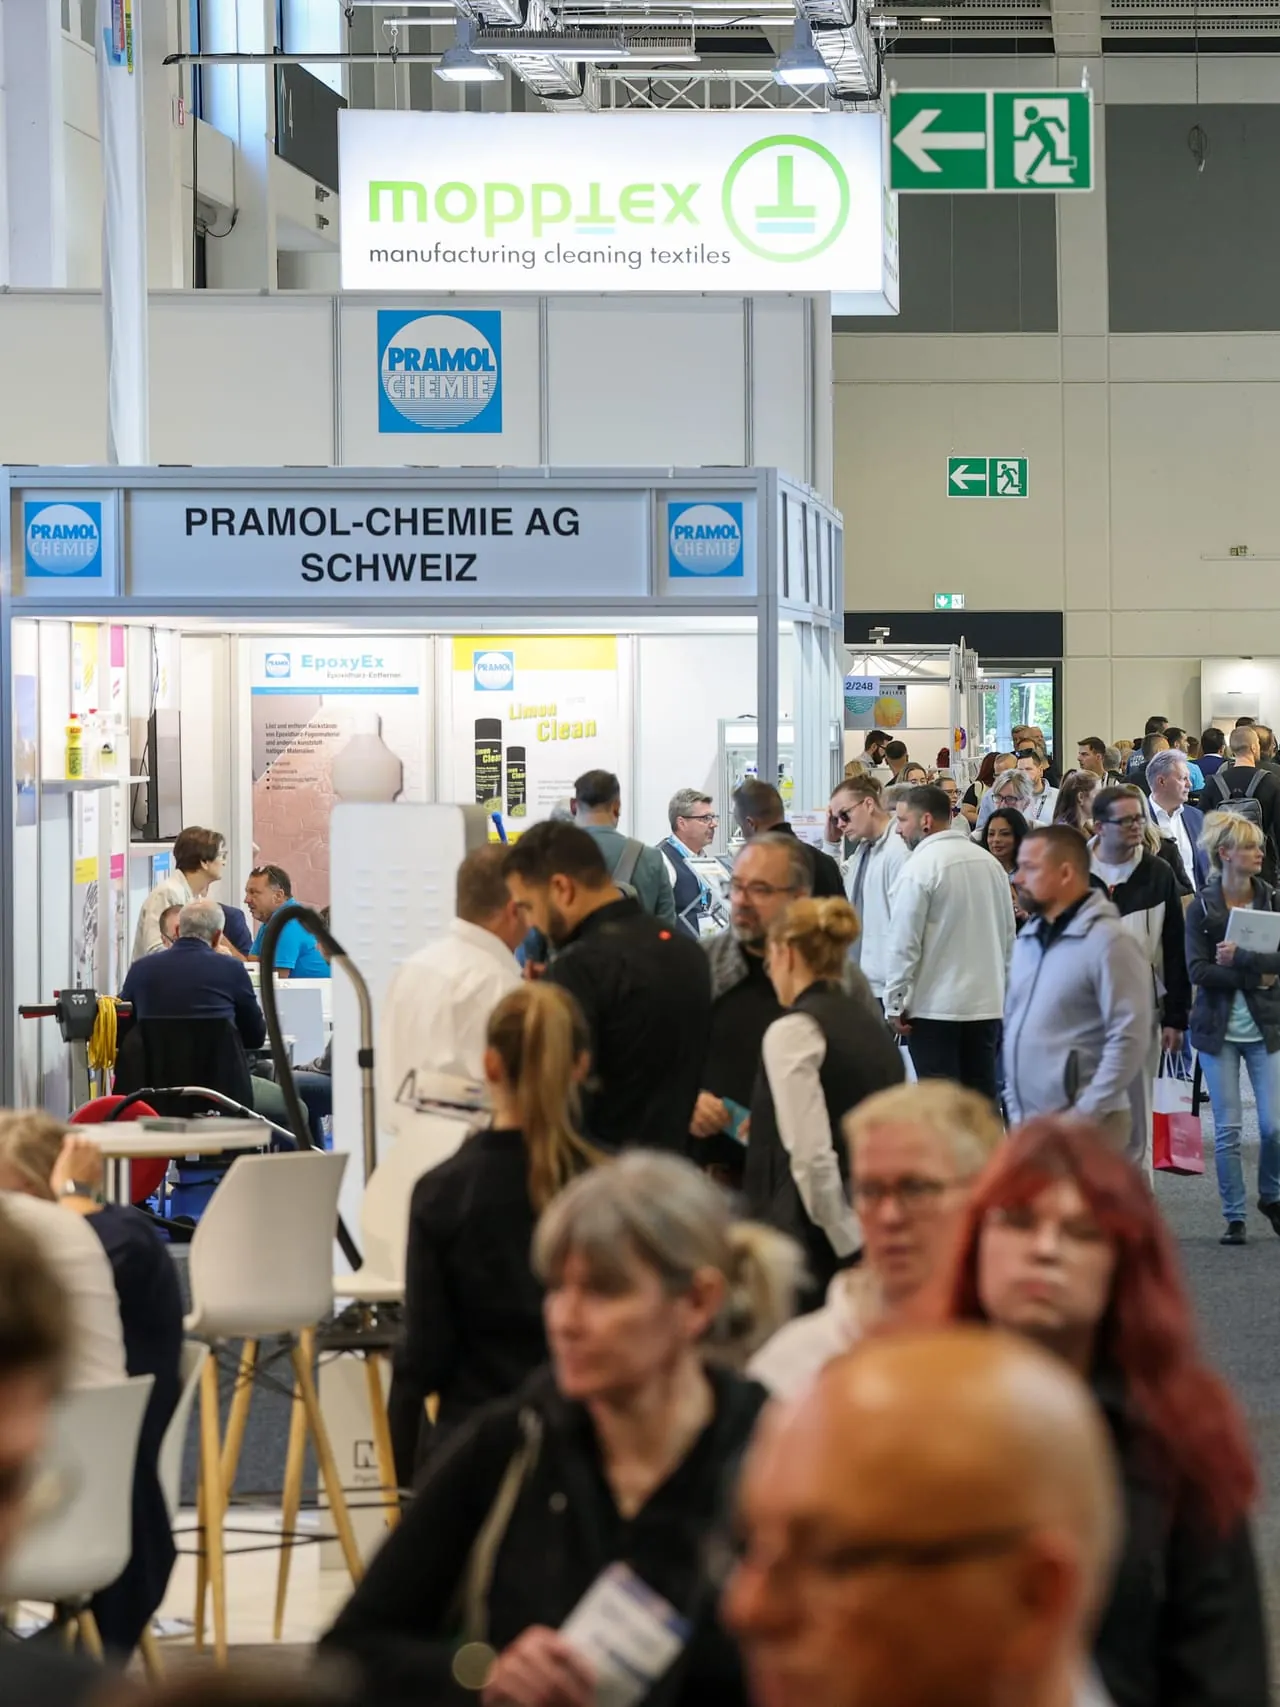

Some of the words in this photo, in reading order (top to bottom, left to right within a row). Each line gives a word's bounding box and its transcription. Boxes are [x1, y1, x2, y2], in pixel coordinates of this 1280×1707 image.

[369, 243, 536, 269] manufacturing
[544, 243, 642, 270] cleaning
[650, 243, 731, 264] textiles
[387, 347, 496, 371] PRAMOL
[387, 374, 490, 400] CHEMIE
[185, 506, 513, 537] PRAMOL-CHEMIE
[525, 506, 580, 537] AG
[31, 523, 98, 541] PRAMOL
[674, 524, 740, 541] PRAMOL
[31, 541, 97, 556] CHEMIE
[674, 541, 737, 557] CHEMIE
[301, 552, 478, 583] SCHWEIZ
[301, 654, 385, 671] EpoxyEx
[477, 663, 512, 672] PRAMOL
[508, 702, 557, 721] Limon
[536, 719, 597, 742] Clean
